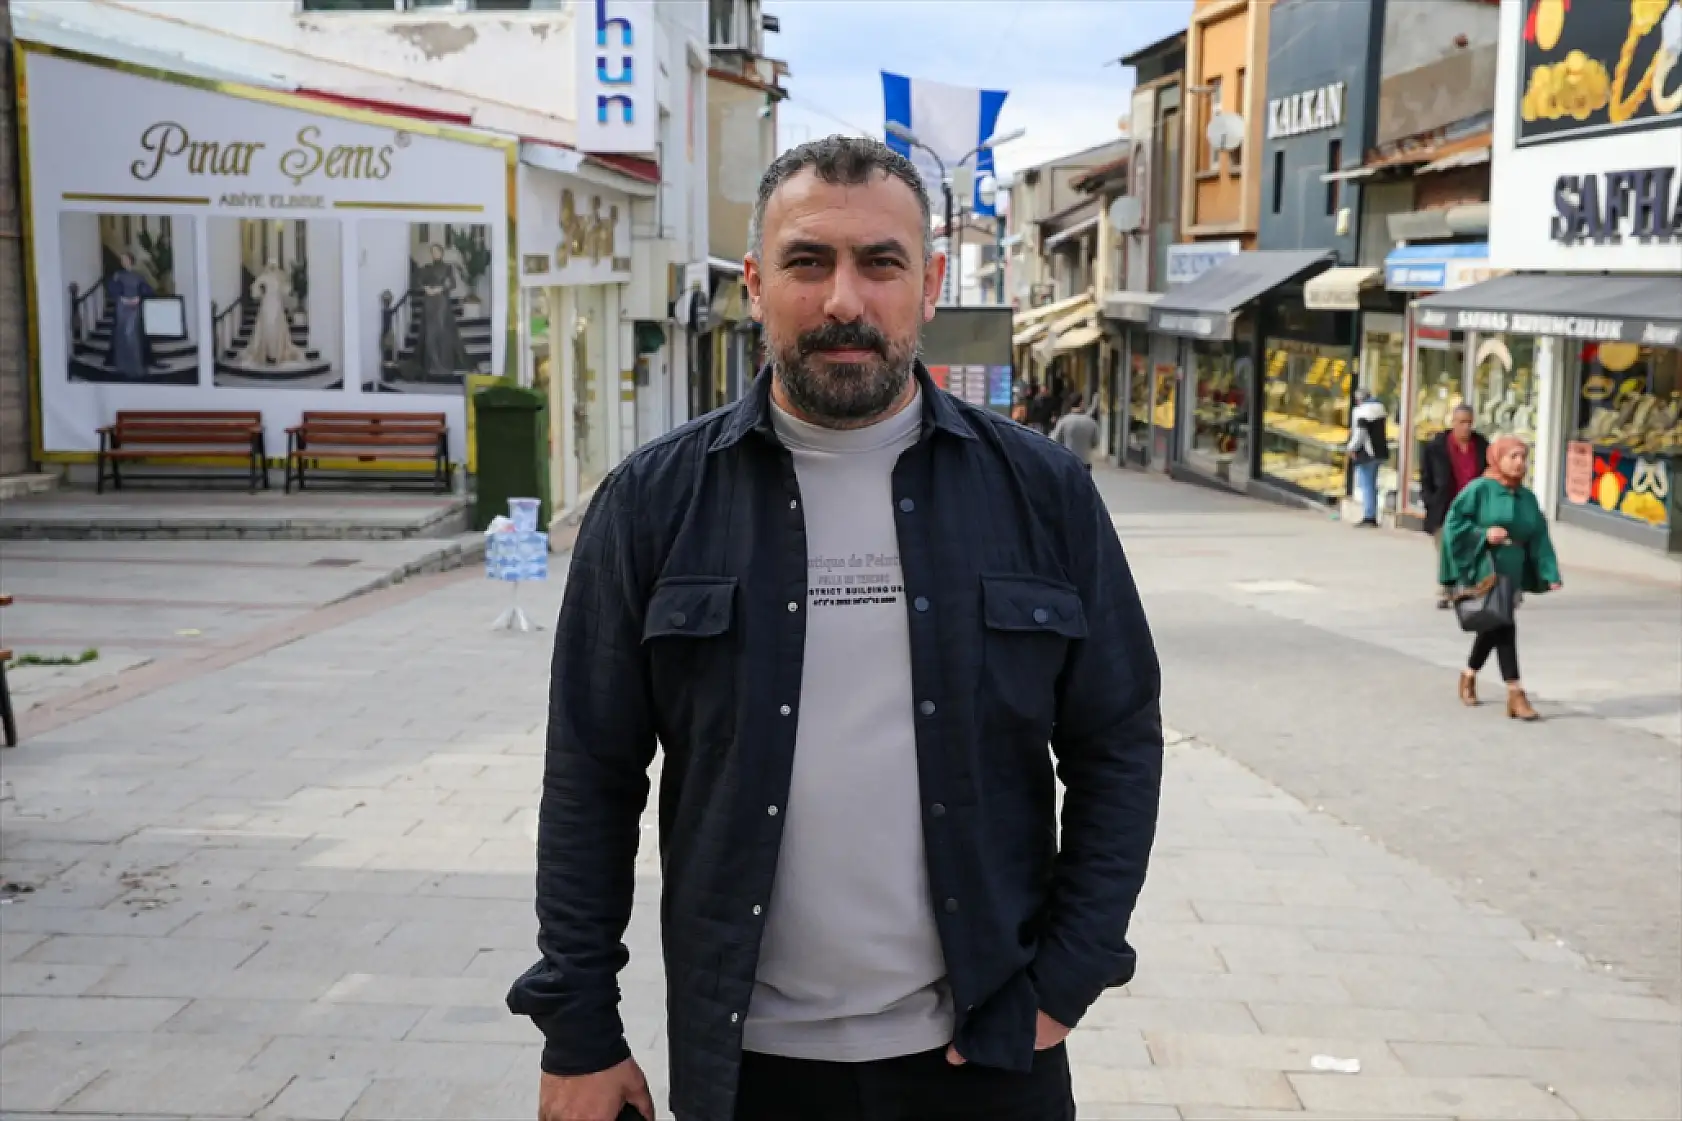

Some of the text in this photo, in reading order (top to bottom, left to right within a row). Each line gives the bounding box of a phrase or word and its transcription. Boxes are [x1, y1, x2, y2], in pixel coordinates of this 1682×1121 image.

[1268, 82, 1344, 139] KALKAN
[130, 120, 394, 186] Pınar Şems
[1550, 166, 1682, 245] SAFH
